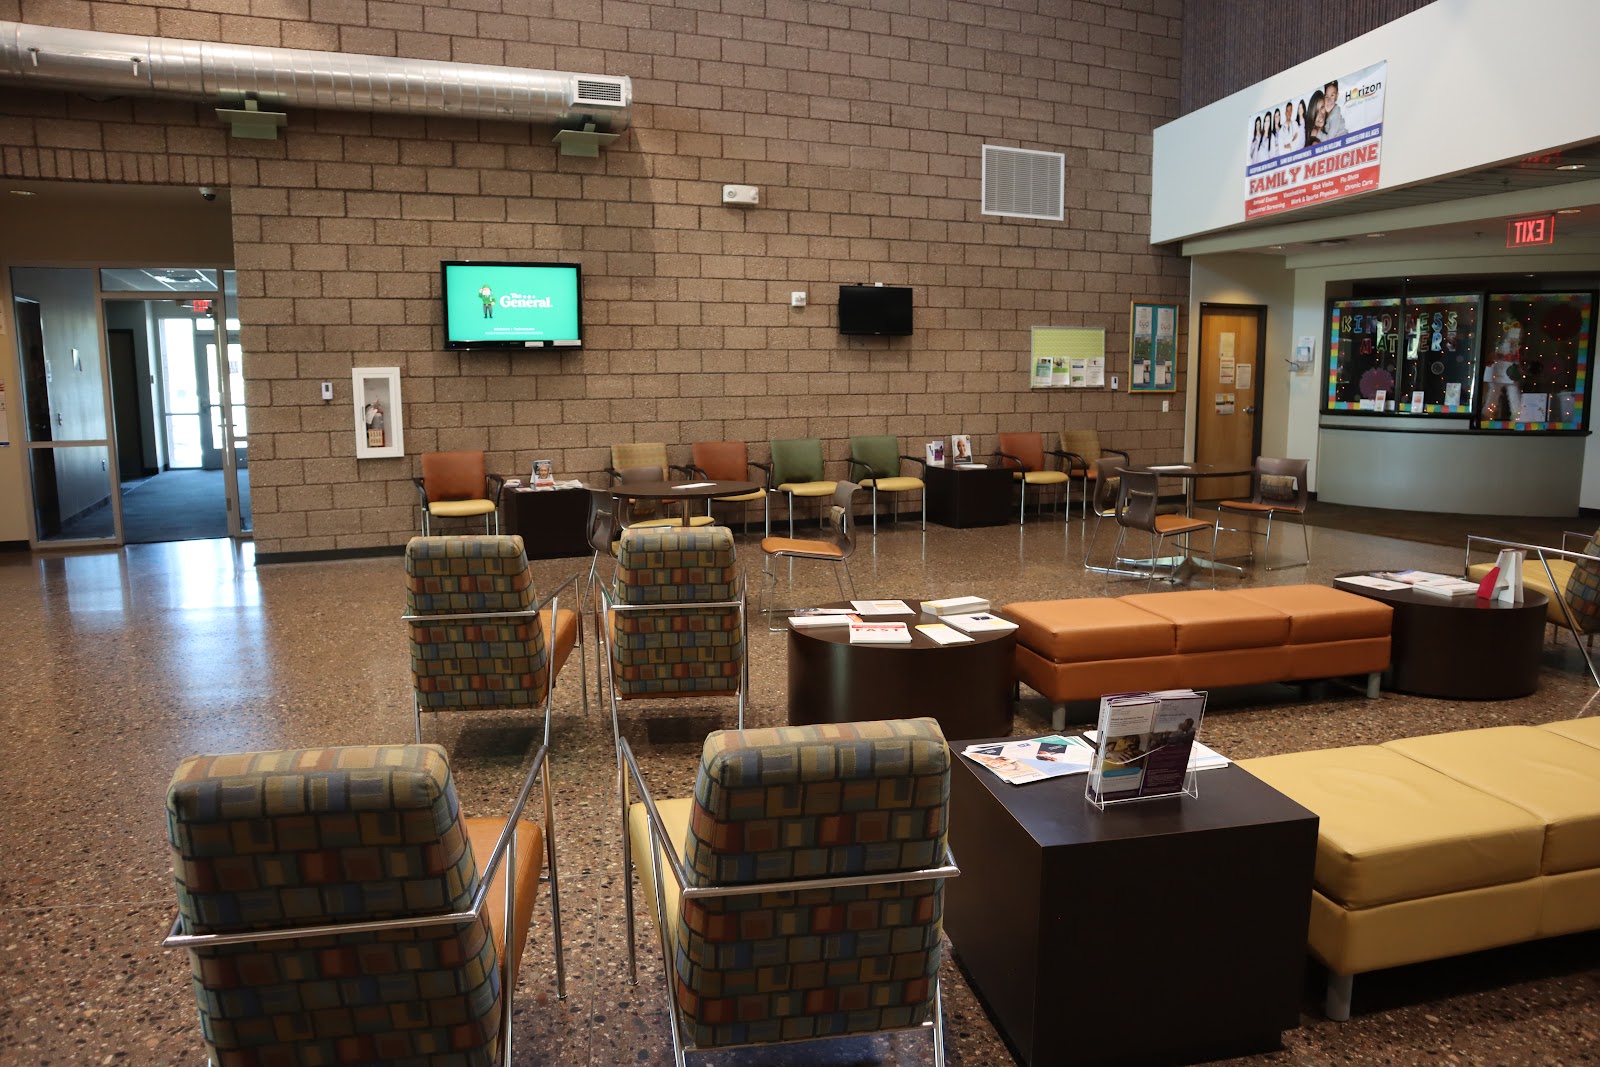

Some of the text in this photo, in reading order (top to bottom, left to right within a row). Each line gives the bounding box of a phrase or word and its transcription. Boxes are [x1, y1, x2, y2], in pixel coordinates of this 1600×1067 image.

[1345, 82, 1382, 101] Horizon
[1249, 166, 1302, 195] FAMILY
[1303, 143, 1379, 180] MEDICINE
[1362, 179, 1374, 187] Care
[500, 295, 551, 308] General
